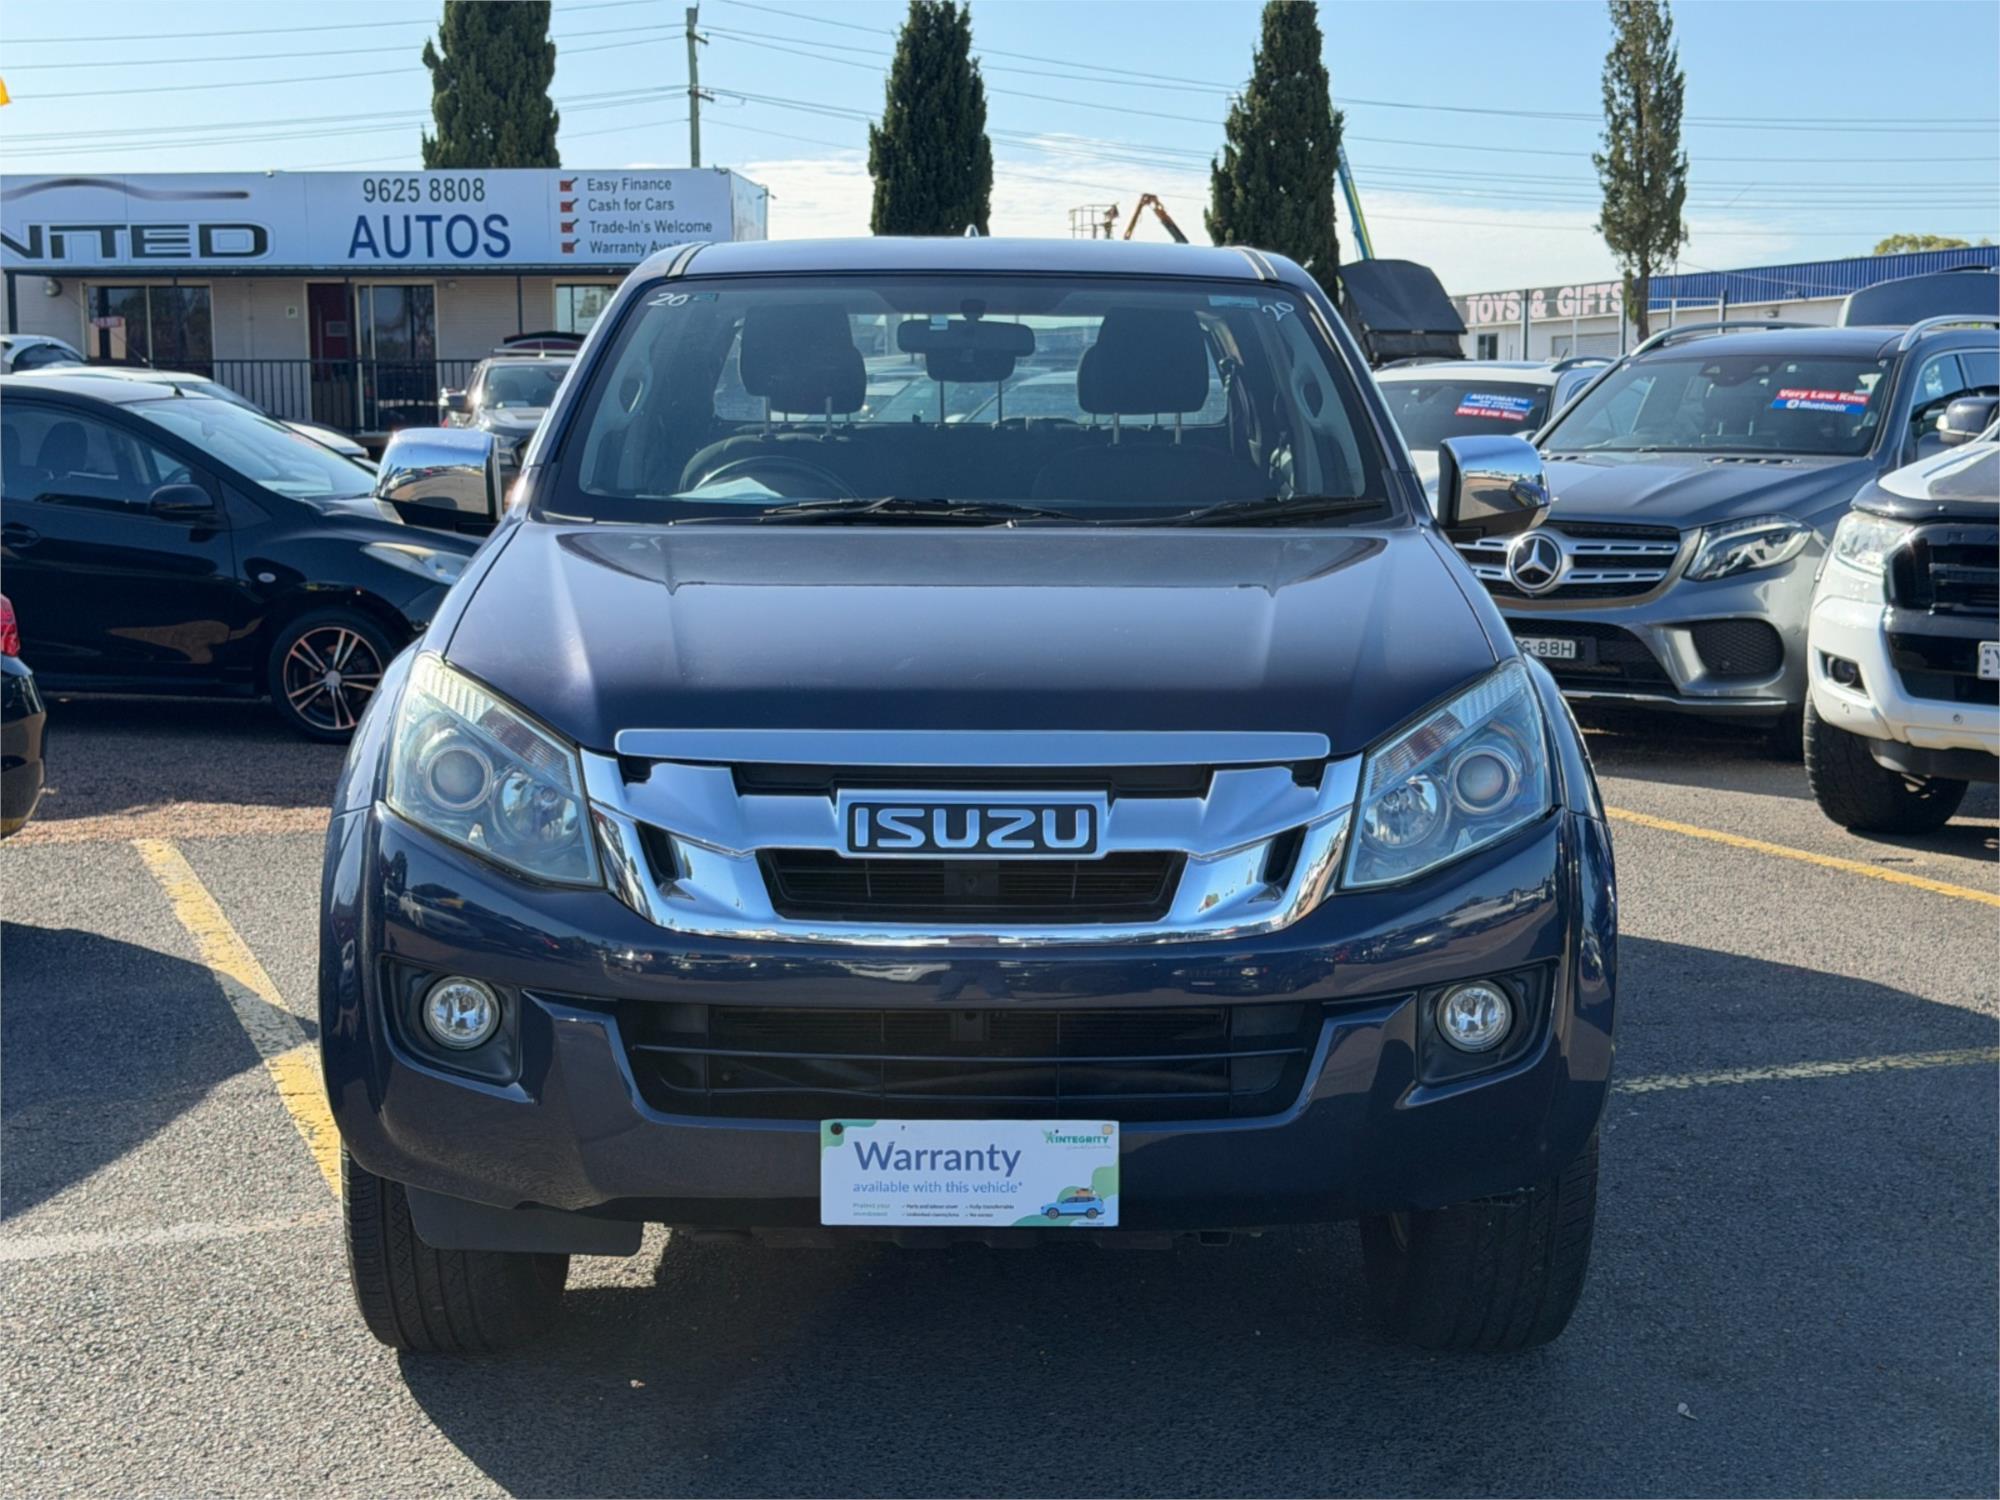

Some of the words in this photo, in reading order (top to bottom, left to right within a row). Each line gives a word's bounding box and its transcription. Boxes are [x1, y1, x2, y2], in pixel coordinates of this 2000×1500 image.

[362, 178, 421, 203] 9625
[429, 177, 486, 203] 8808
[587, 178, 618, 194] Easy
[622, 177, 672, 191] Finance
[588, 199, 621, 212] Cash
[624, 199, 642, 211] for
[645, 198, 675, 211] Cars
[590, 220, 651, 234] Trade-In's
[654, 219, 713, 233] Welcome
[348, 214, 512, 259] AUTOS
[590, 241, 647, 256] Warranty
[647, 292, 690, 307] 20
[1466, 291, 1521, 324] TOYS
[1530, 290, 1547, 319] &
[1557, 281, 1625, 317] GIFTS
[854, 807, 1090, 849] ISUZU
[1055, 1135, 1110, 1144] INTEGRITY
[854, 1141, 1022, 1178] Warranty
[852, 1181, 910, 1193] available
[913, 1181, 942, 1193] with
[945, 1181, 969, 1193] this
